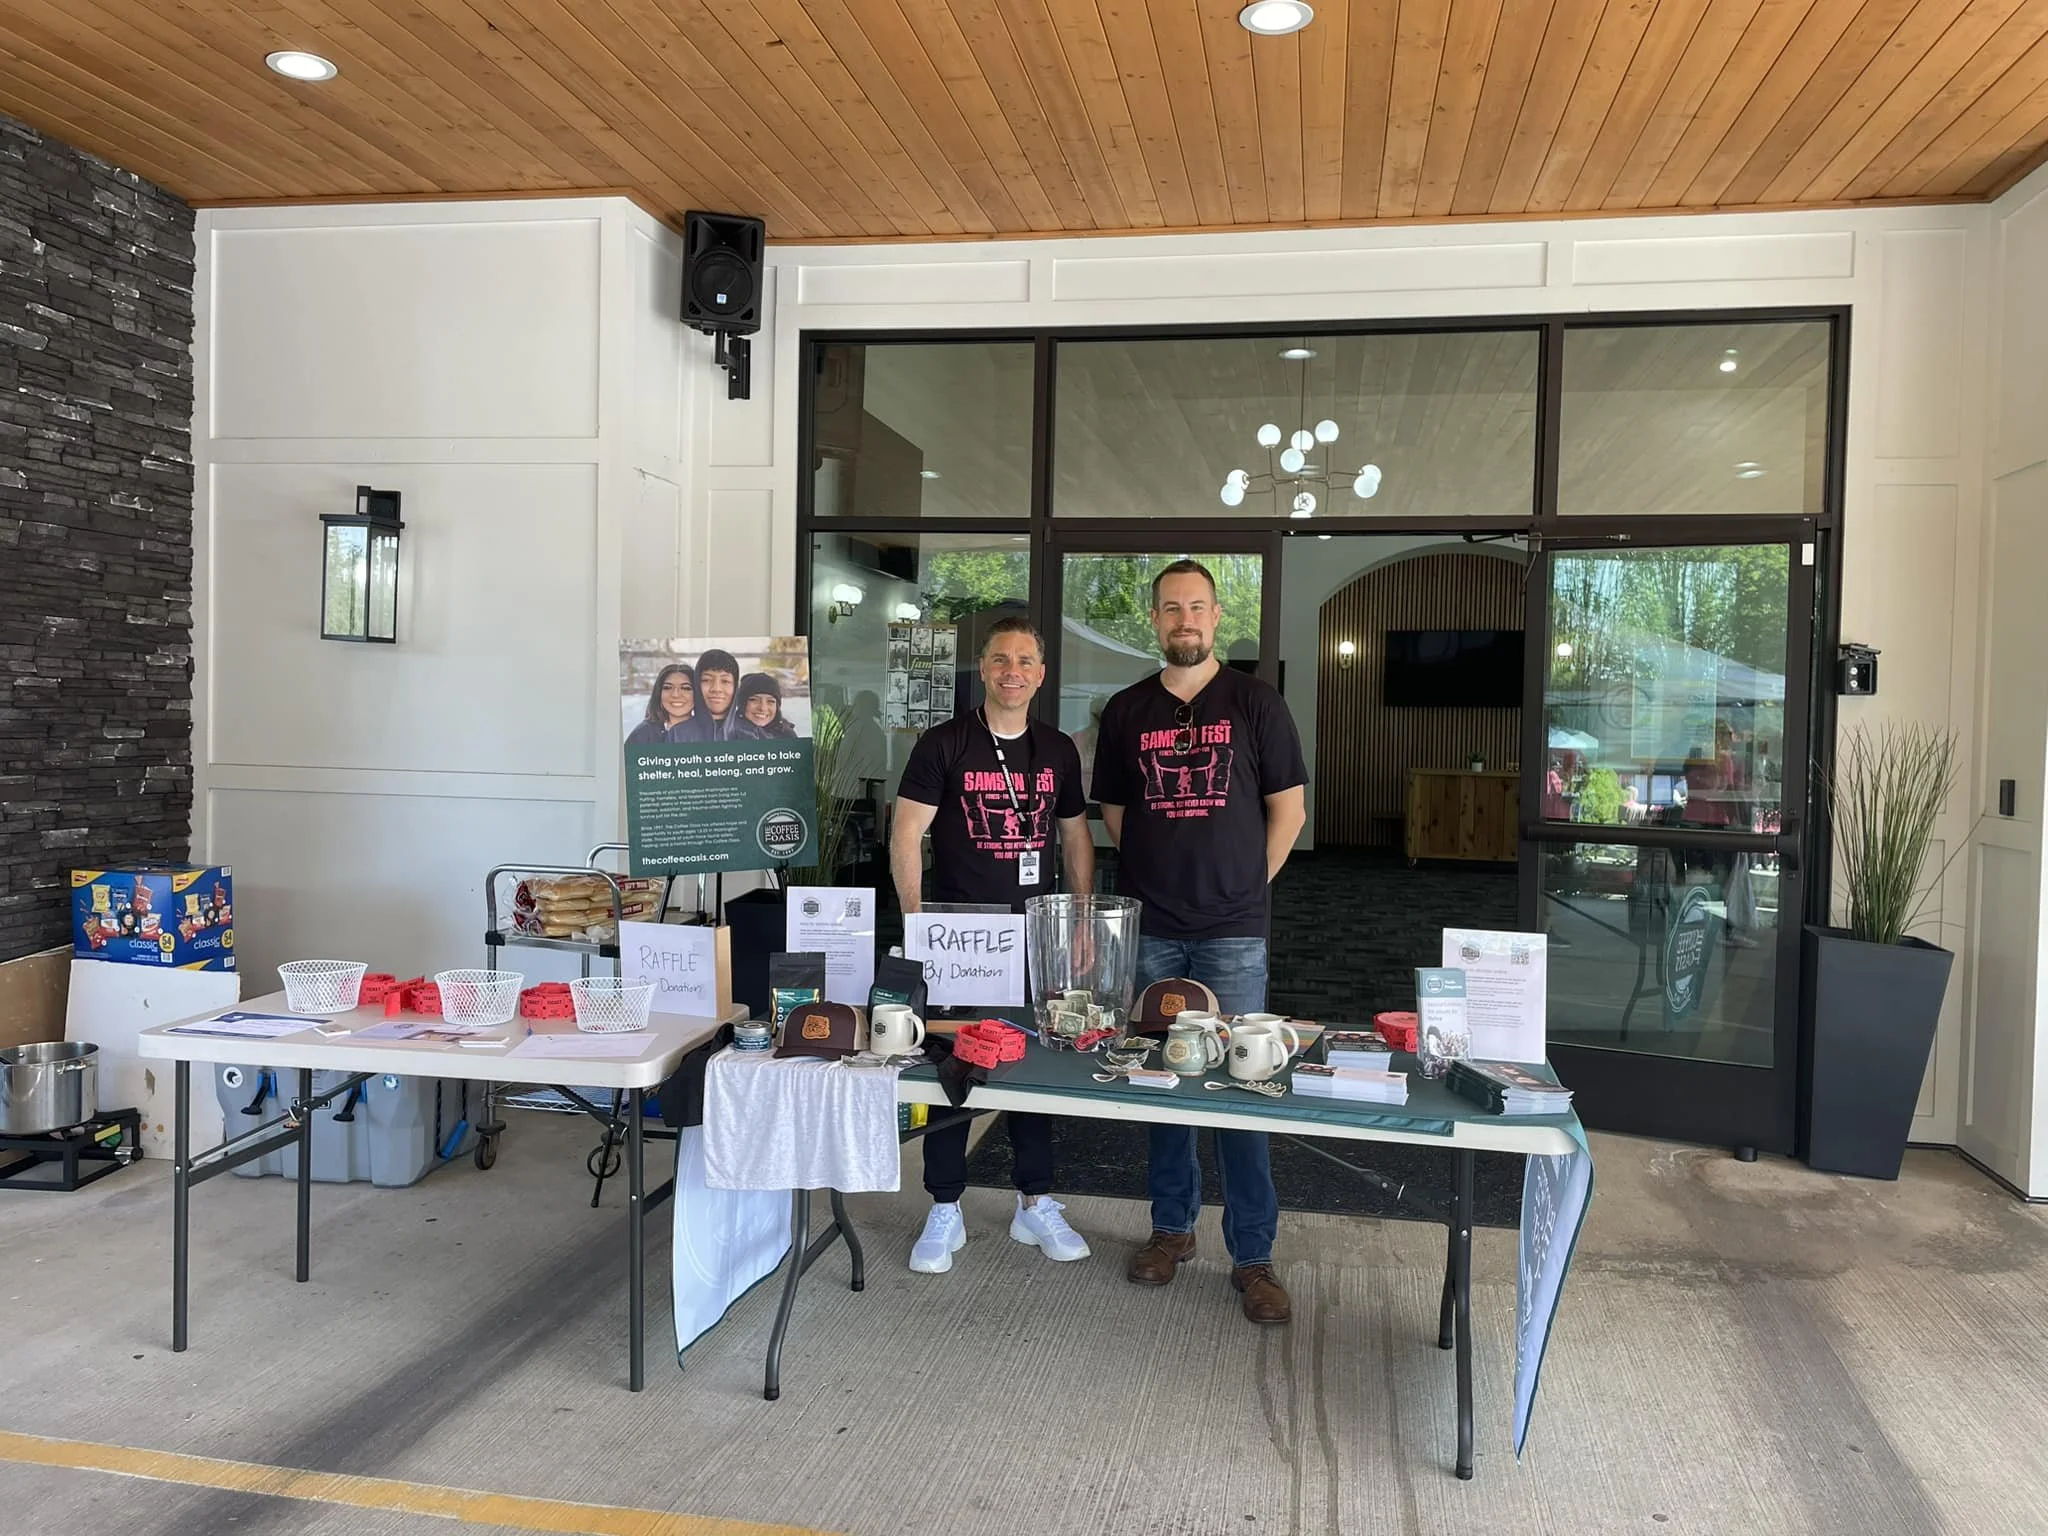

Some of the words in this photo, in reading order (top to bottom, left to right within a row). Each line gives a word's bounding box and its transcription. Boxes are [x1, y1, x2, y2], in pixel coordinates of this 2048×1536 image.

[1140, 727, 1197, 751] SAMSN
[1201, 724, 1232, 744] FEST
[637, 756, 672, 767] Giving
[674, 755, 702, 767] youth
[704, 756, 712, 764] a
[713, 753, 735, 763] safe
[737, 752, 765, 763] place
[767, 751, 777, 761] to
[779, 750, 801, 760] take
[638, 769, 675, 781] shelter,
[677, 767, 703, 779] heal,
[705, 766, 743, 778] belong,
[745, 765, 765, 775] and
[767, 765, 794, 777] grow.
[1034, 773, 1054, 792] EST
[771, 824, 799, 835] COFFEE
[771, 833, 800, 842] OASIS
[642, 853, 729, 865] thecoffeeoasis.com
[129, 938, 158, 949] classic
[162, 936, 172, 945] 54
[193, 936, 221, 950] classic
[928, 923, 1016, 954] RAFFLE
[639, 945, 701, 972] RAFFLE
[924, 960, 942, 985] By
[951, 963, 1003, 979] Donation
[660, 977, 703, 993] Donation
[979, 1044, 994, 1053] TICKET
